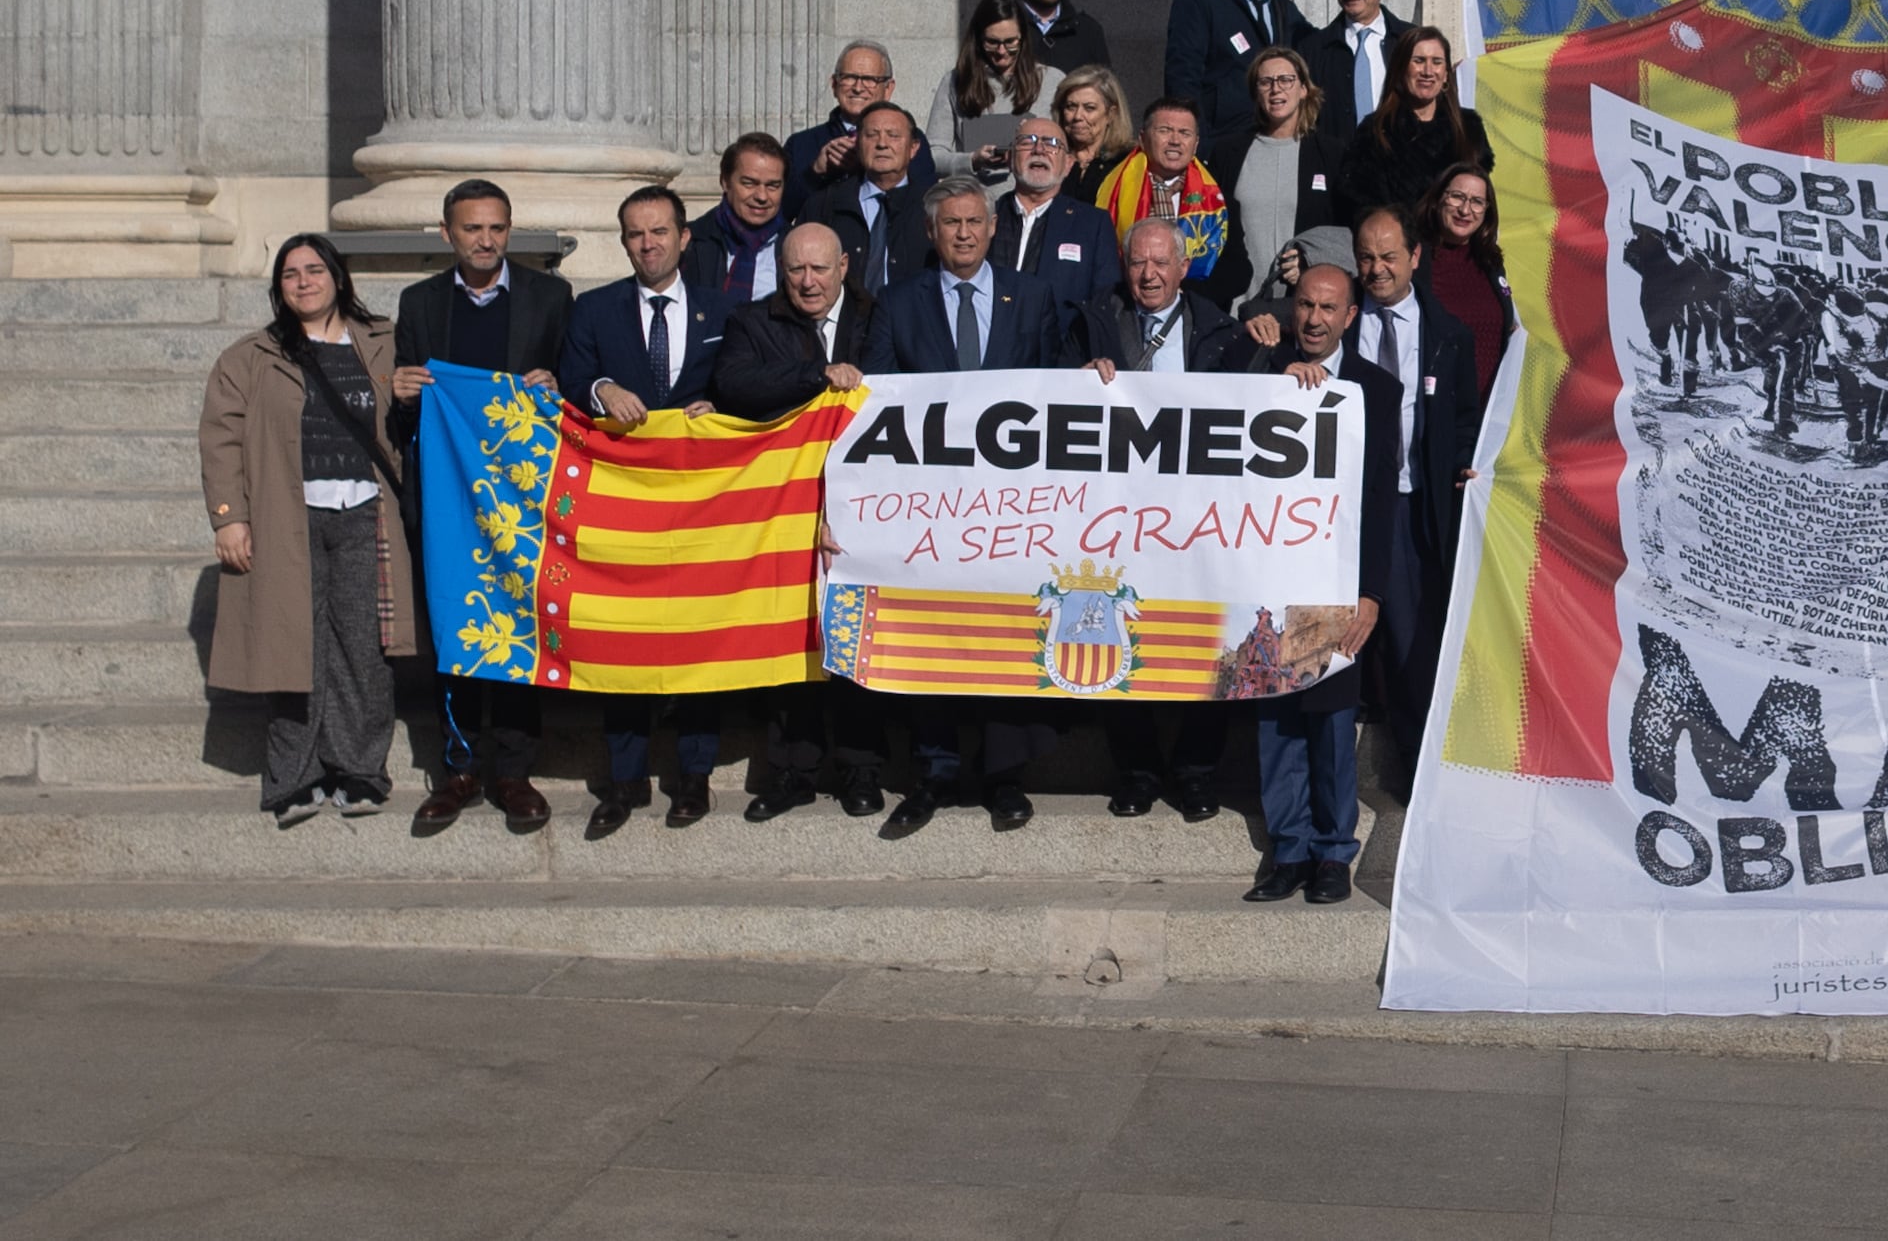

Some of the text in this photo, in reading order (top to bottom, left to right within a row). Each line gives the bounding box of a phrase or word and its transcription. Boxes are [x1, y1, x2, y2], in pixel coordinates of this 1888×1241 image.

[1630, 118, 1675, 157] EL
[843, 390, 1346, 480] ALGEMESÍ
[850, 482, 1088, 523] TORNAREM
[904, 494, 1340, 564] A SER GRANS!
[1766, 973, 1888, 1003] juristes
